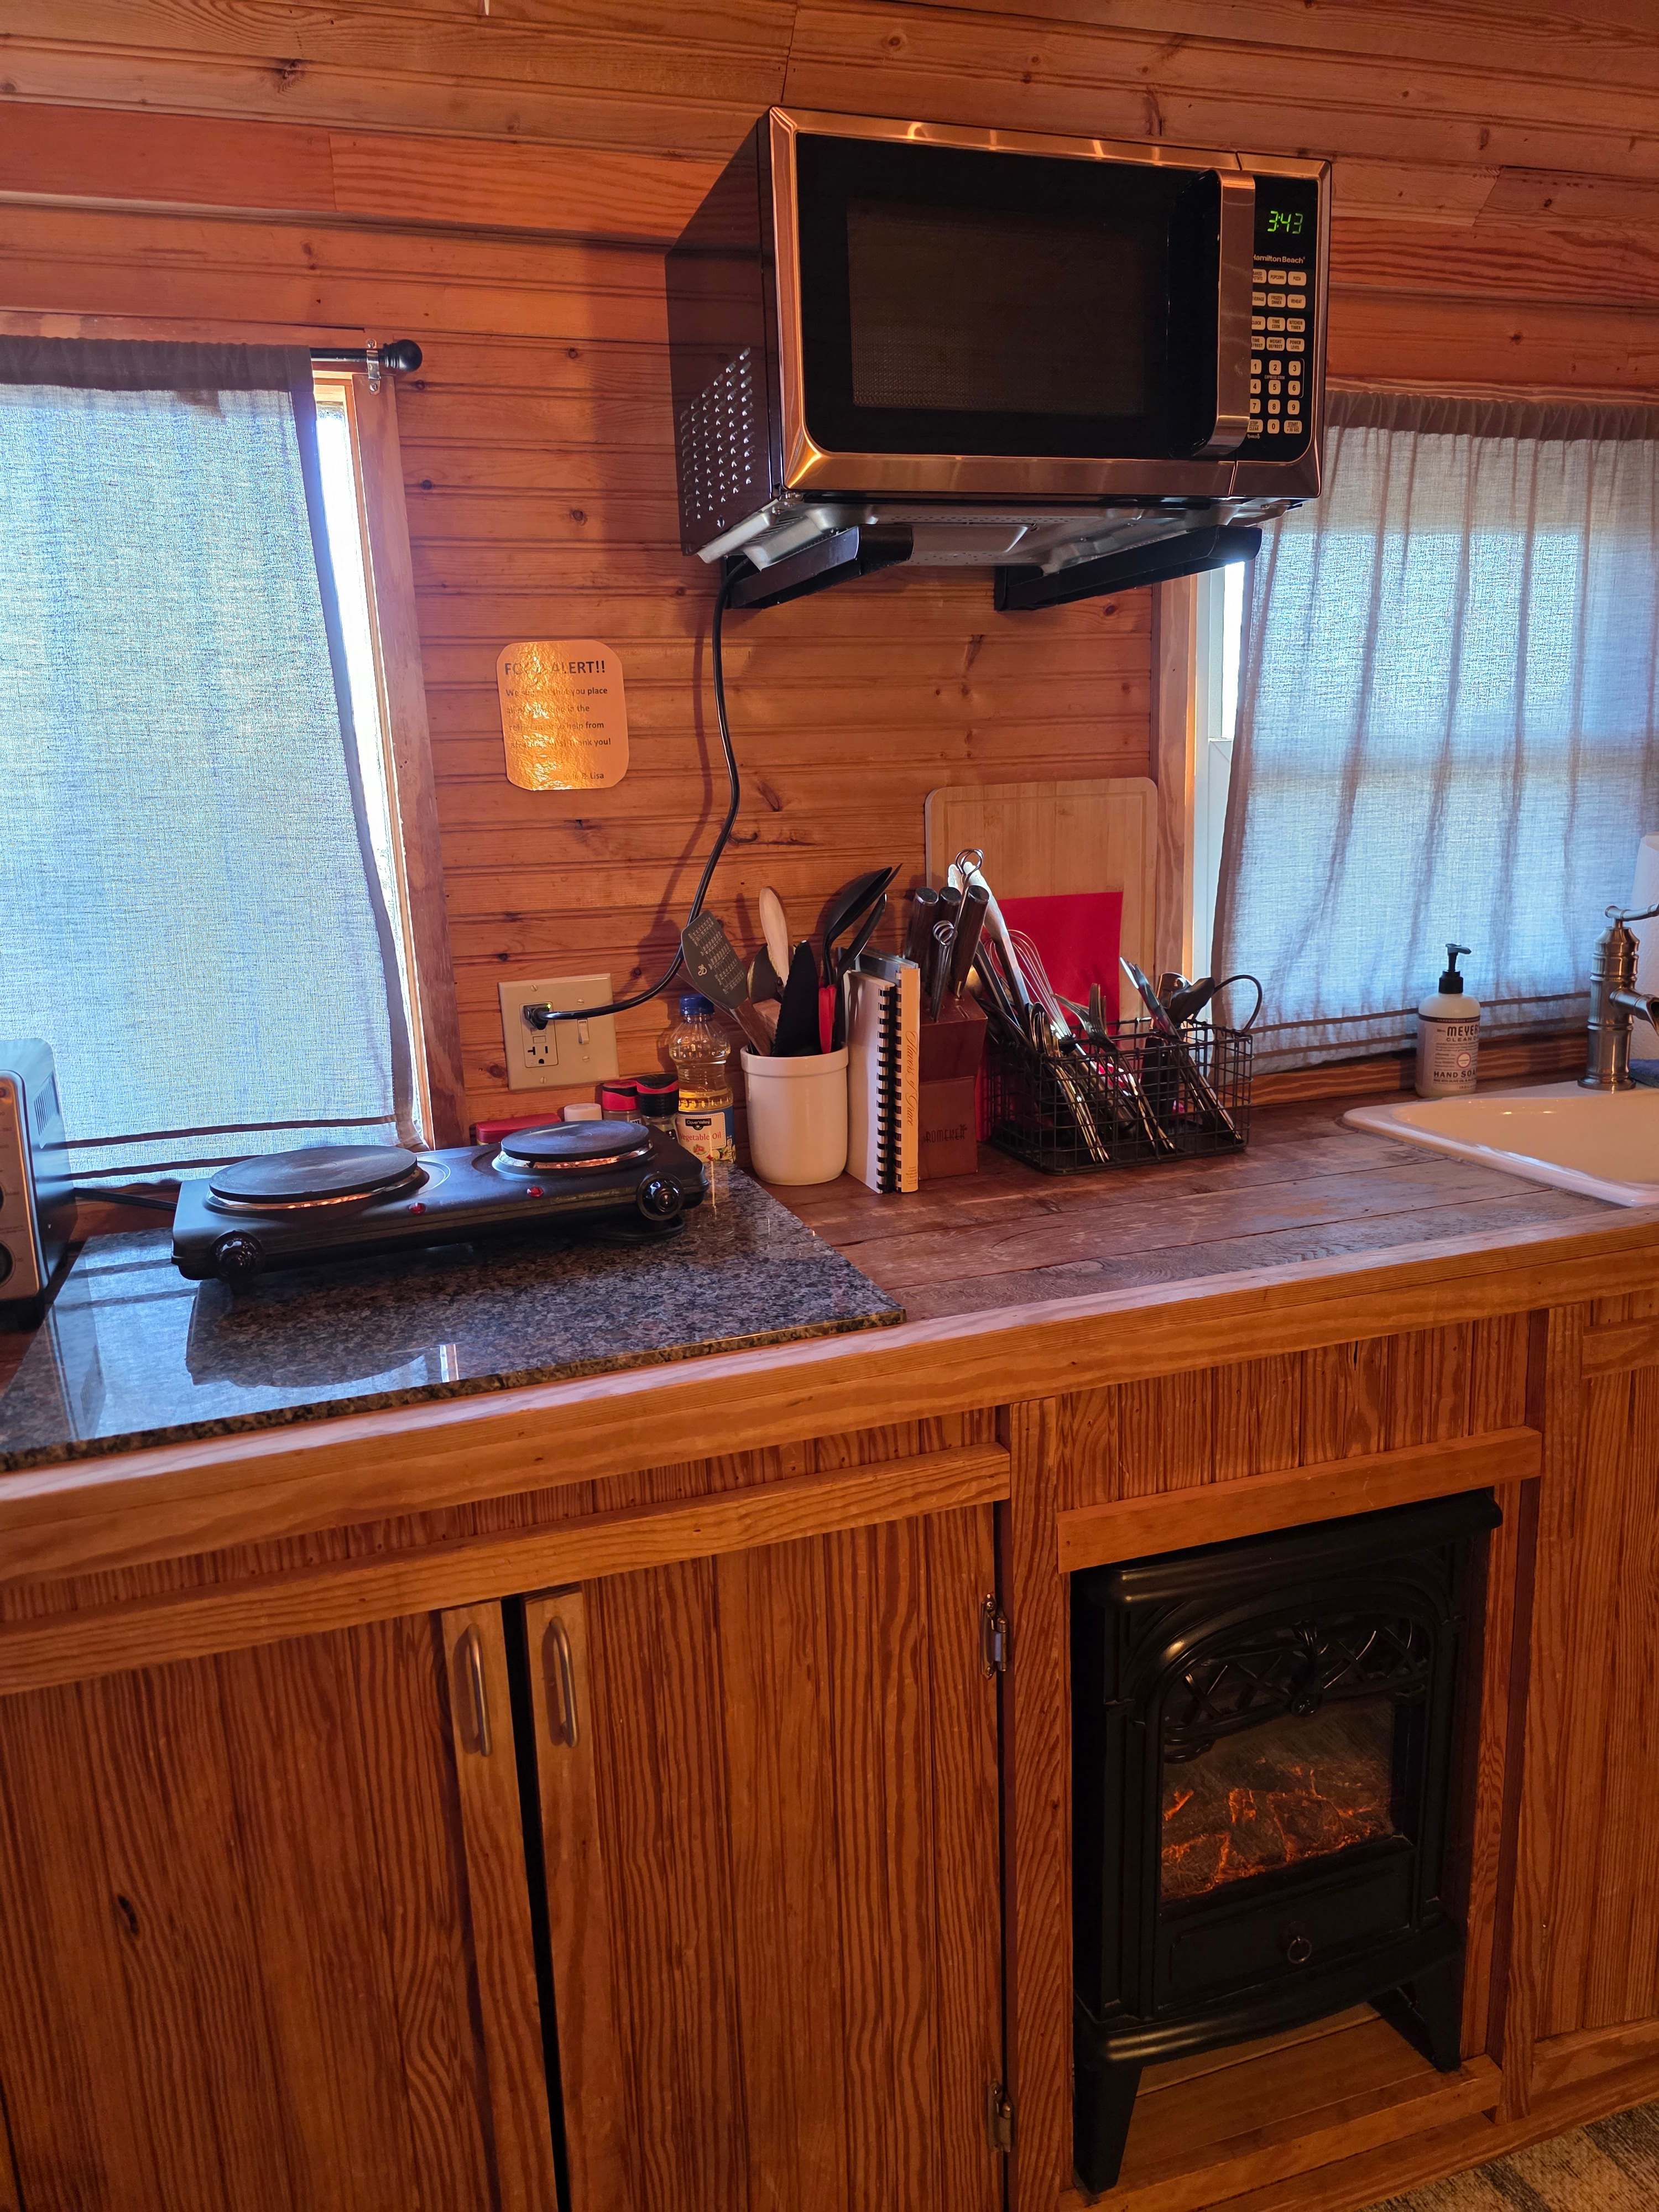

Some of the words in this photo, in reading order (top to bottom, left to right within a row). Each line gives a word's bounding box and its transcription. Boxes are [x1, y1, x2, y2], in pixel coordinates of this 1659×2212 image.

[1267, 210, 1303, 234] 3:43
[551, 660, 605, 674] ALERT!!
[587, 687, 608, 696] place
[594, 738, 611, 747] you!
[1460, 1068, 1477, 1078] SOA
[712, 1131, 721, 1140] Oil
